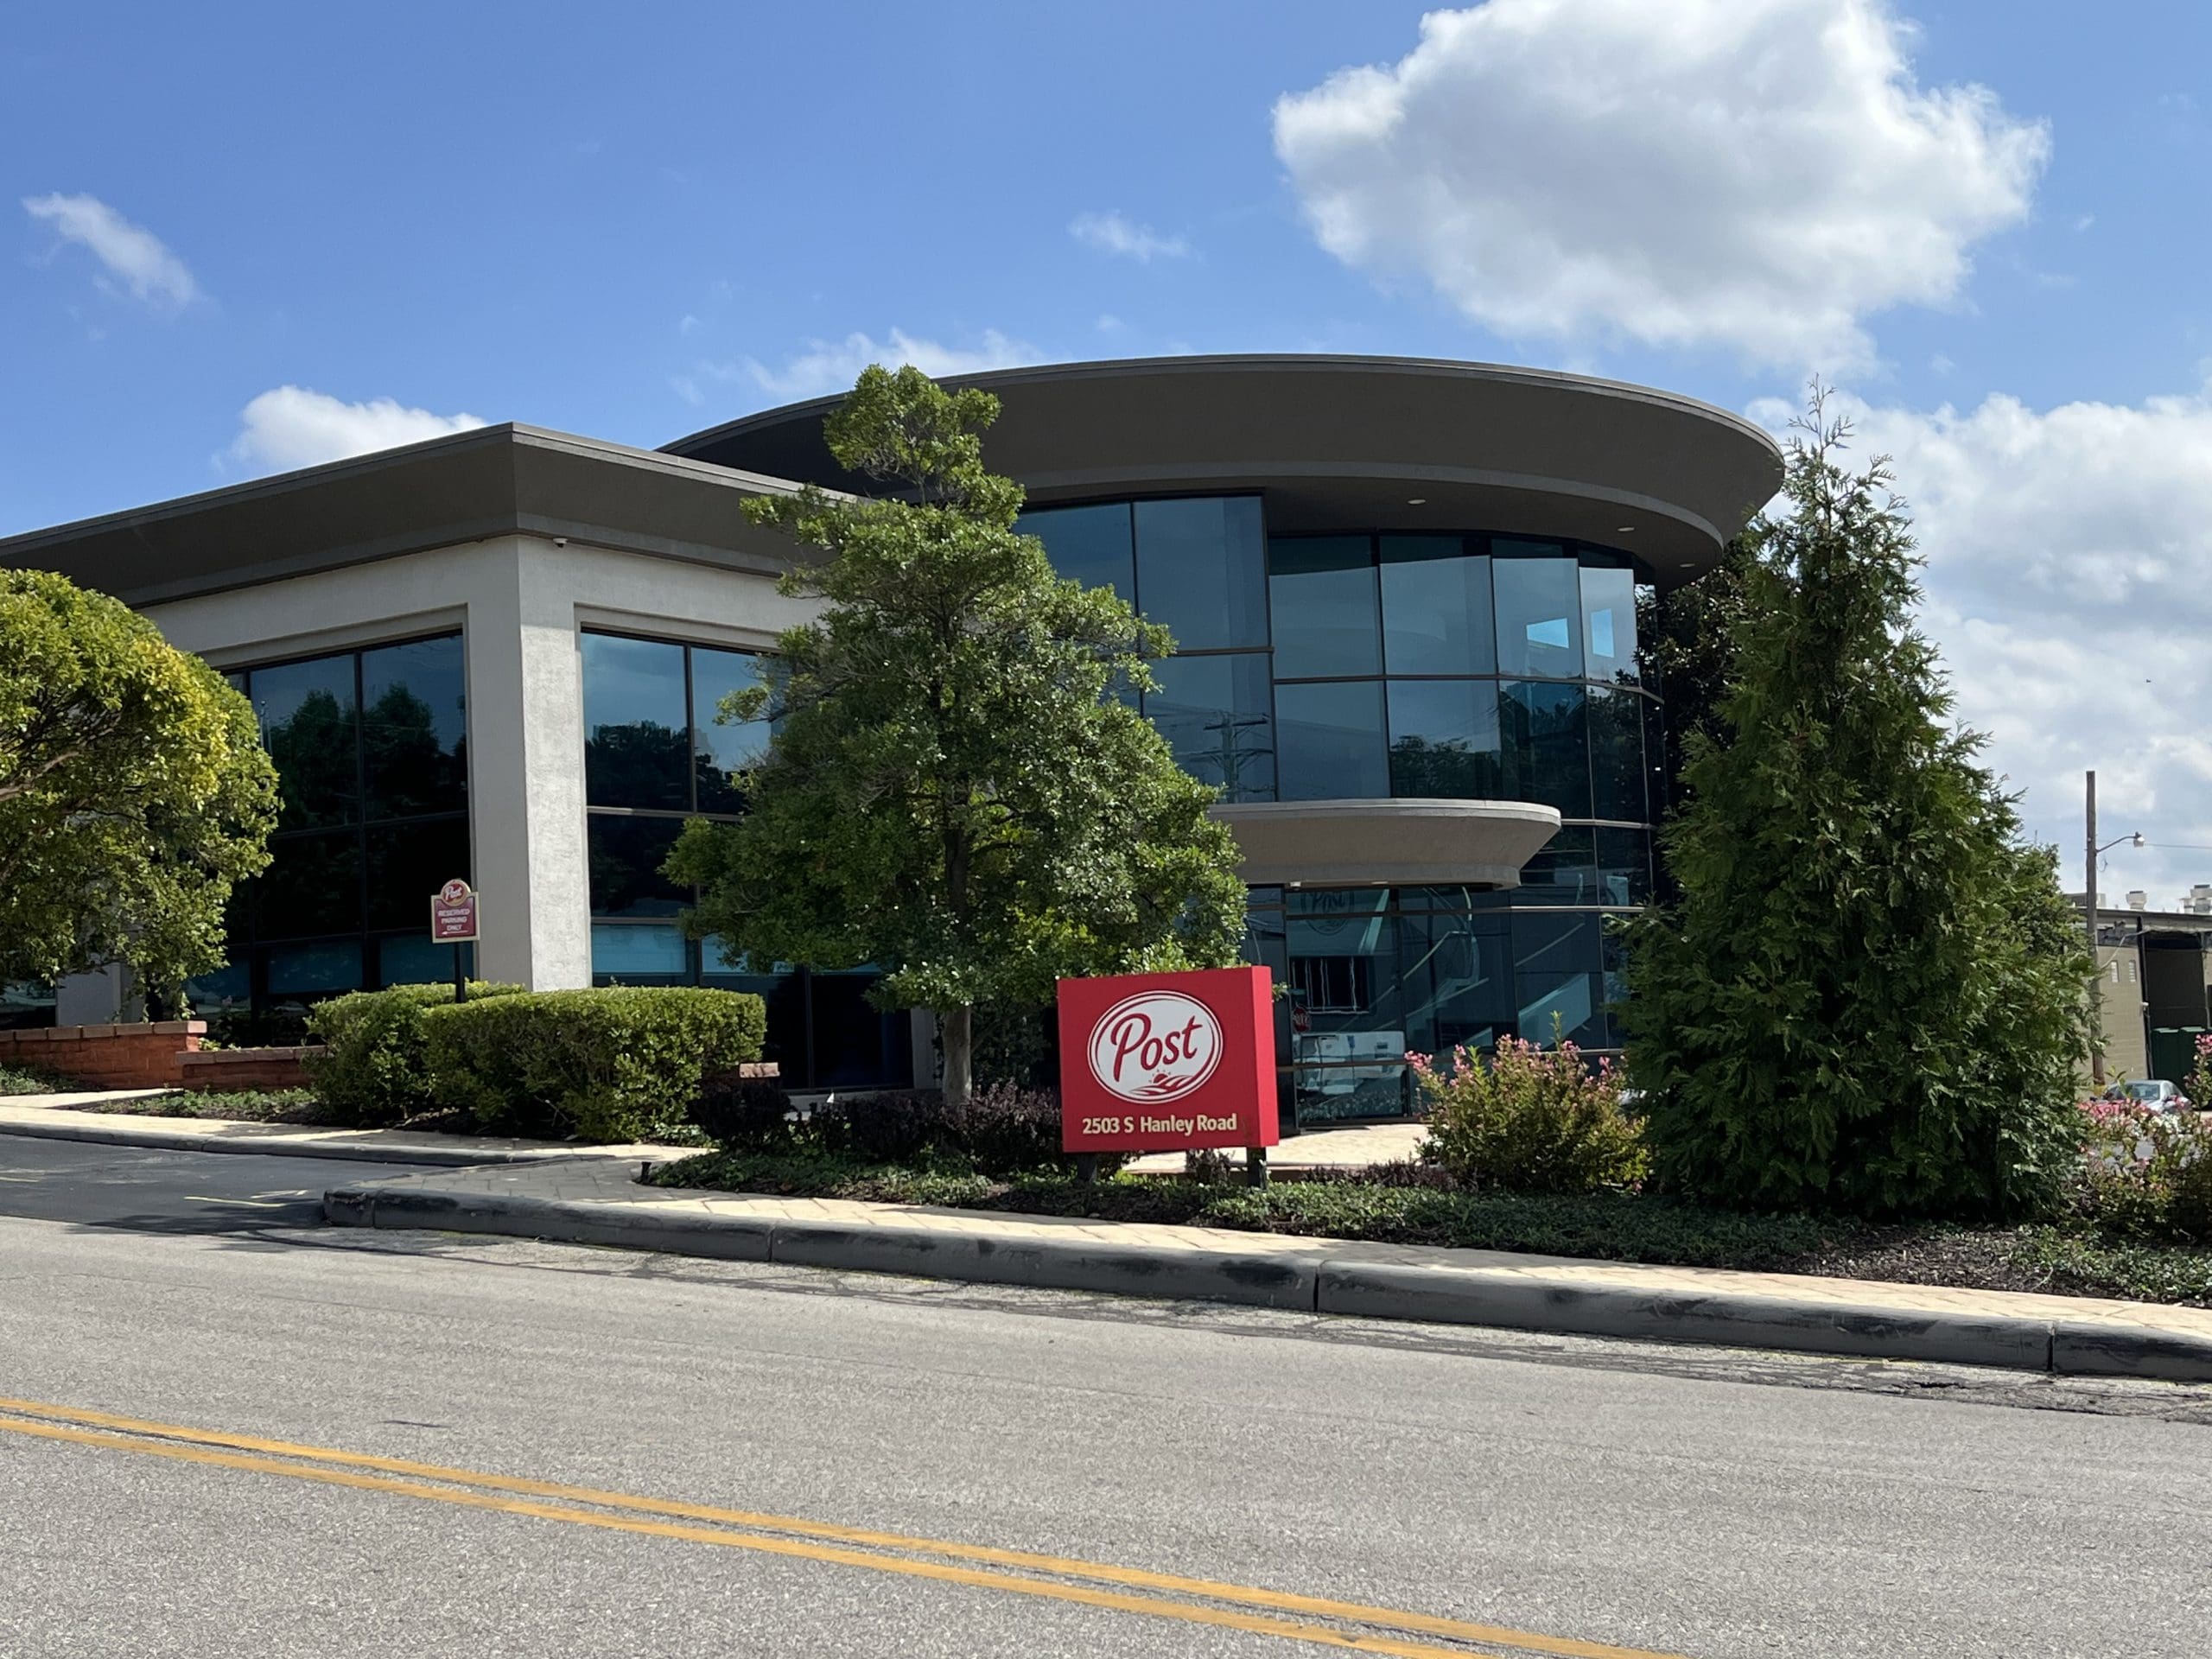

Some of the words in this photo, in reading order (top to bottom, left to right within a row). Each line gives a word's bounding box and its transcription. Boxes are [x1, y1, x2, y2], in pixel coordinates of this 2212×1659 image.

[444, 886, 462, 900] Post
[441, 916, 467, 925] PARKING
[1110, 1013, 1203, 1082] Post
[1082, 1117, 1120, 1135] 2503
[1124, 1116, 1134, 1133] S
[1141, 1115, 1193, 1136] Hanley
[1197, 1113, 1237, 1131] Road
